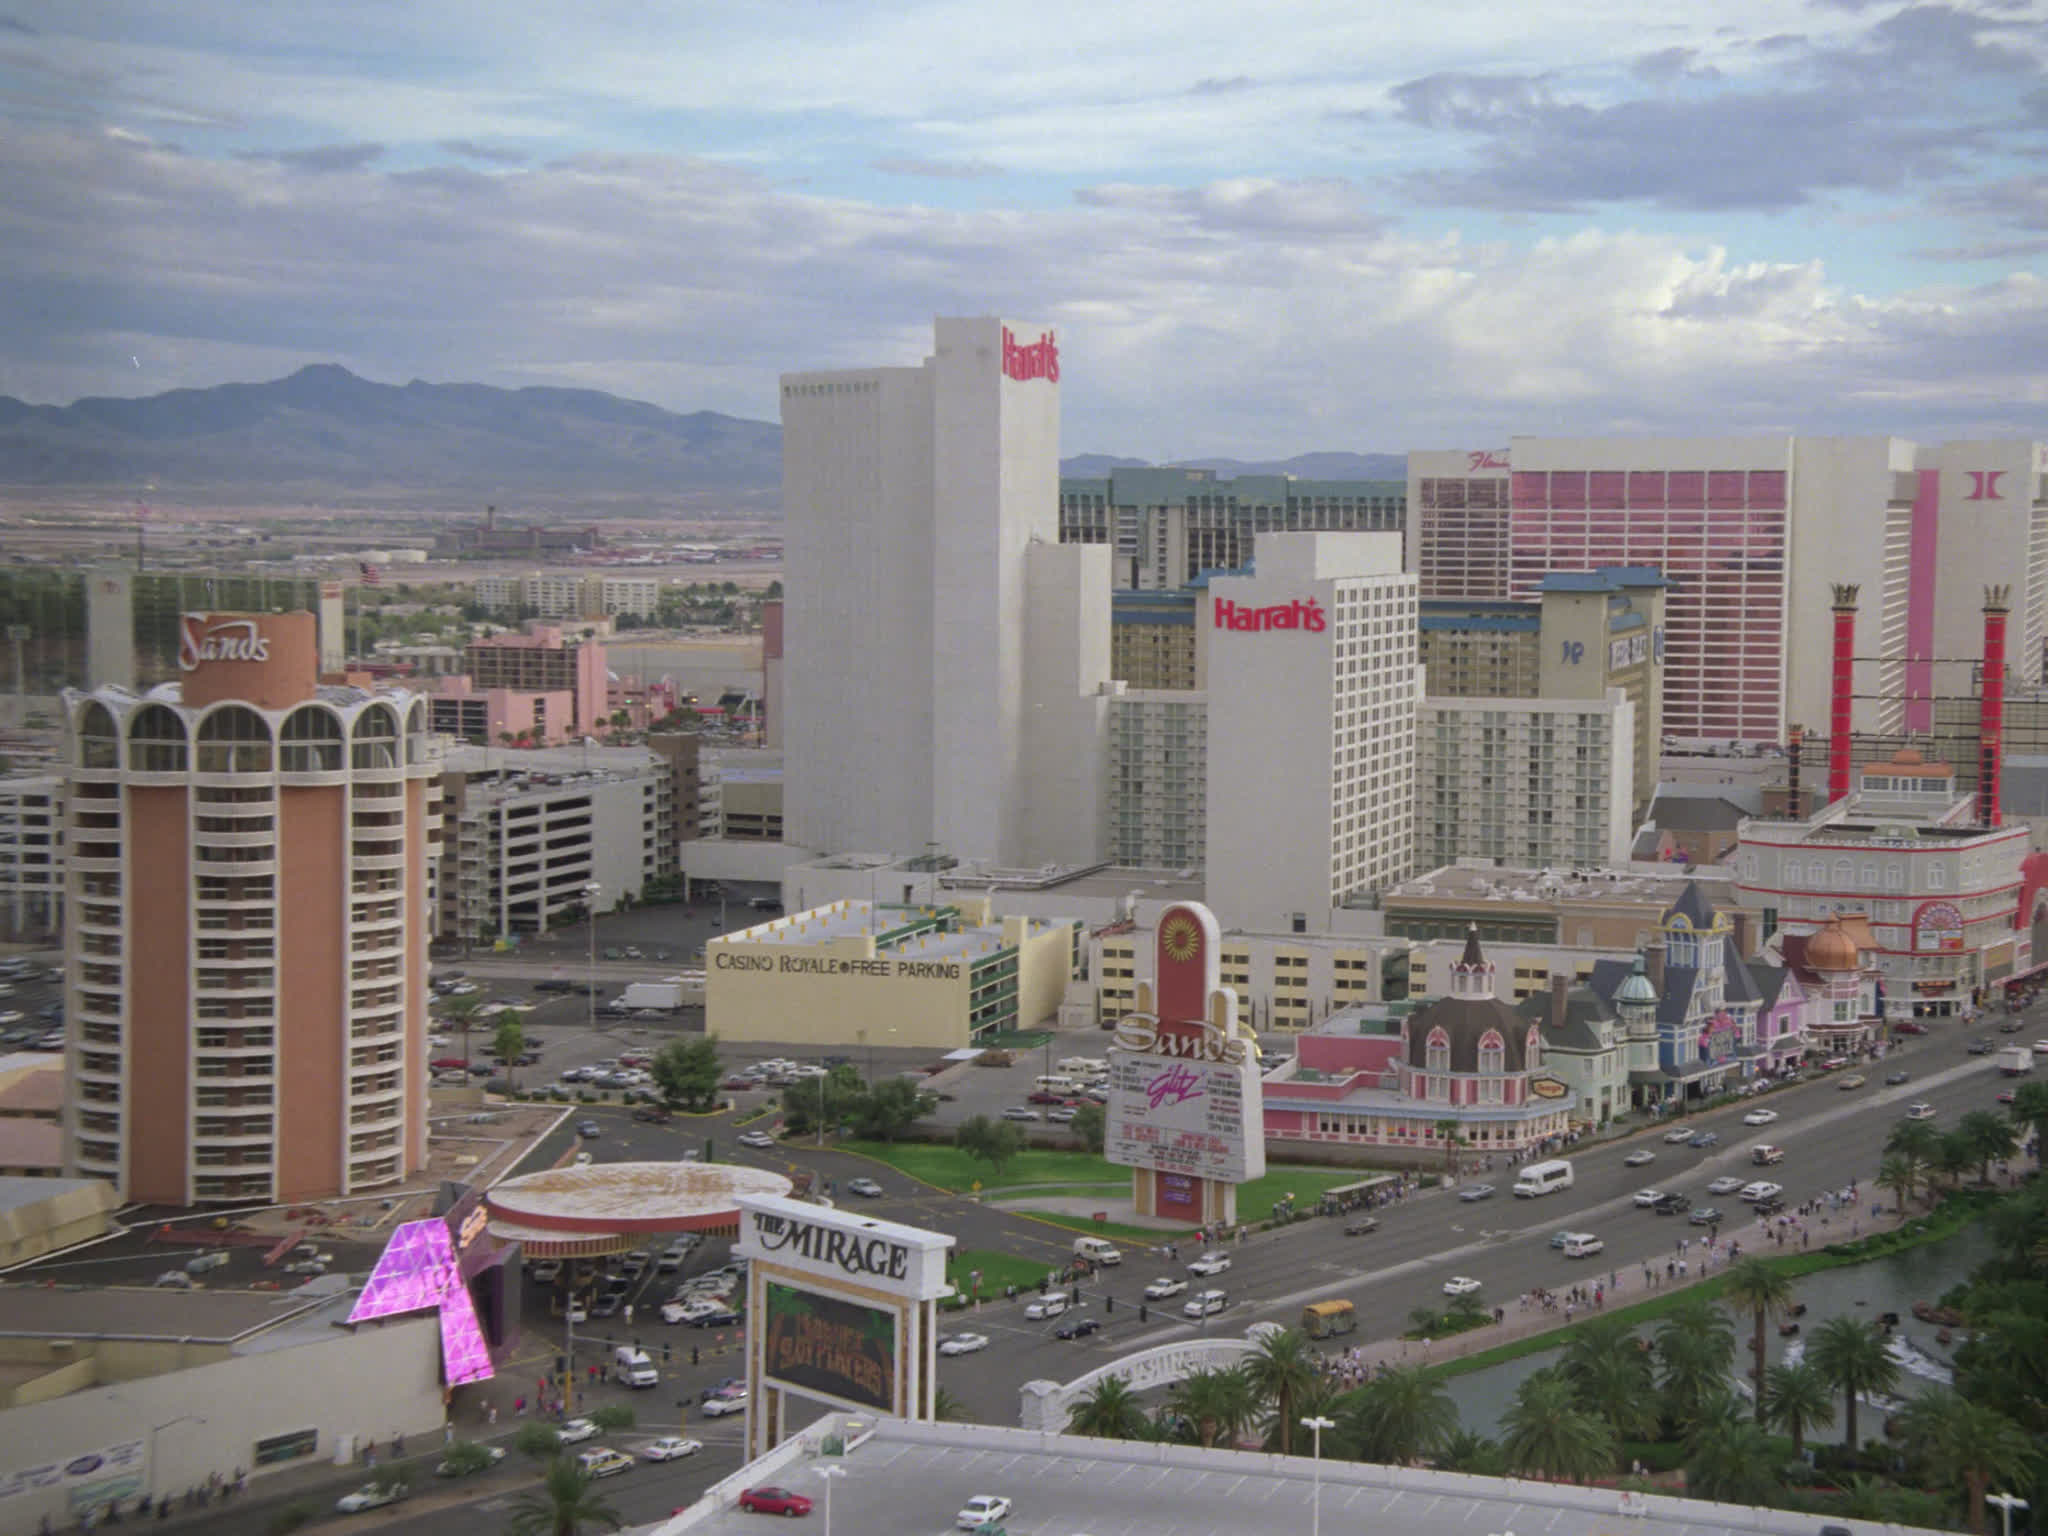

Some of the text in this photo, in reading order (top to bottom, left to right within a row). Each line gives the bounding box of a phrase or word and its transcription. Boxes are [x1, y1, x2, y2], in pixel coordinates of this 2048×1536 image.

[1002, 326, 1059, 383] Harrah's
[178, 611, 271, 671] Sands
[1215, 595, 1326, 633] Harrah's
[715, 952, 960, 980] CASINO ROYALE FREE PARKING
[1112, 1011, 1249, 1065] Sands
[753, 1211, 909, 1281] THE MIRAGE
